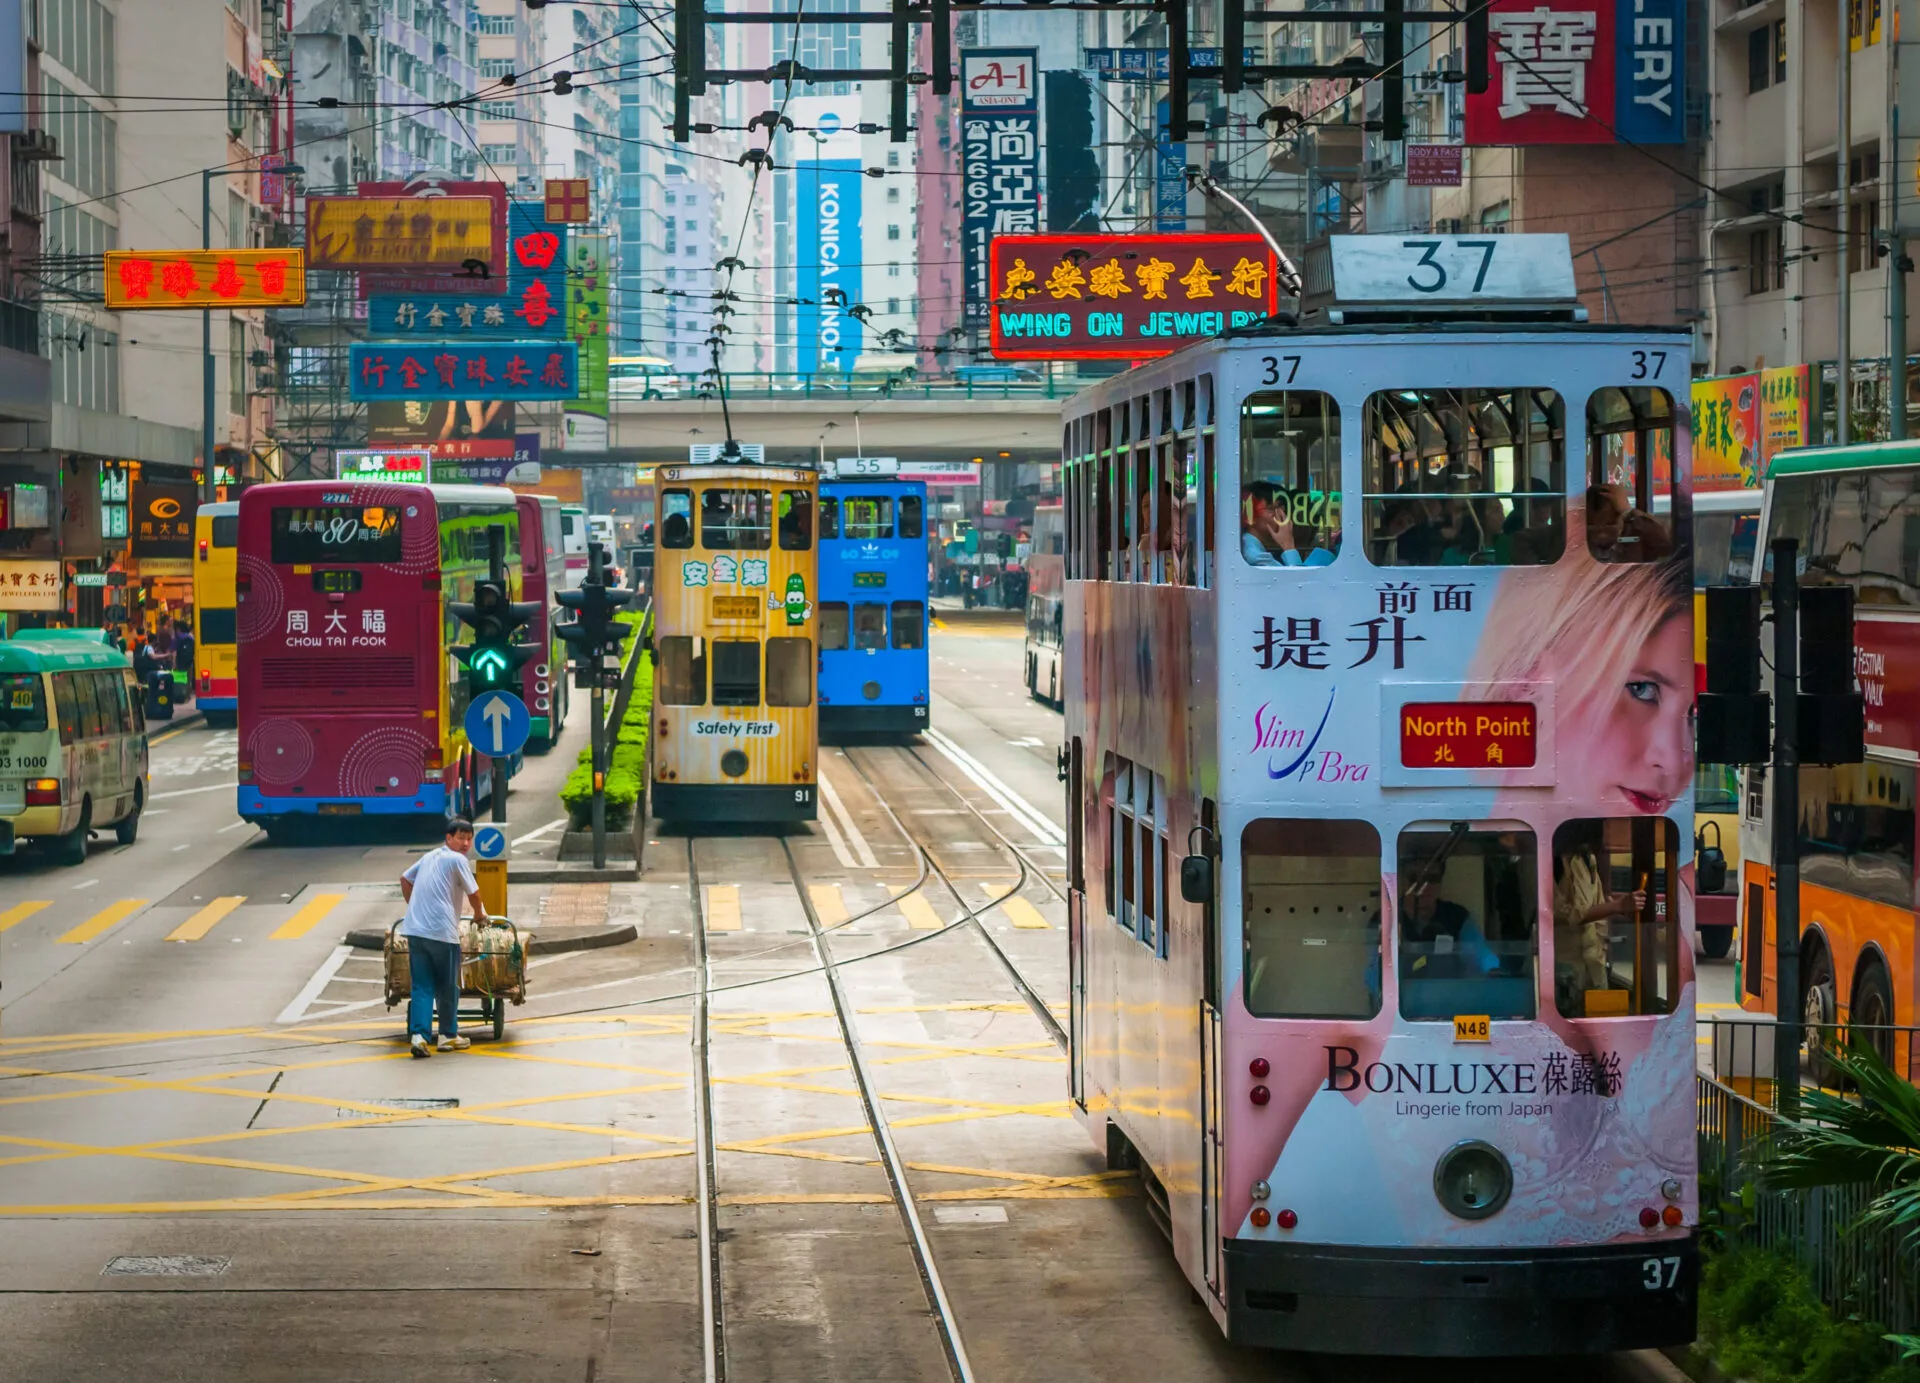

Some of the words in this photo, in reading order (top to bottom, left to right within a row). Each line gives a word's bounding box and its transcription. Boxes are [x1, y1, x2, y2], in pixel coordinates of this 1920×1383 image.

[970, 62, 1028, 89] A-1
[1489, 7, 1597, 119] 寶
[978, 96, 1018, 105] ASIA-ONE
[820, 183, 840, 276] KONICA
[1000, 257, 1268, 300] 永安珠寶金行
[1403, 240, 1497, 293] 37
[820, 283, 840, 371] MINOLT
[1000, 312, 1072, 337] WING
[1087, 312, 1123, 337] ON
[1261, 355, 1302, 385] 37
[1630, 351, 1667, 380] 37
[668, 469, 681, 480] 91
[793, 470, 807, 481] 91
[856, 459, 880, 473] 55
[1375, 582, 1477, 614] 前面
[286, 609, 386, 634] 周大福
[286, 637, 322, 647] CHOW
[326, 637, 346, 647] TAI
[352, 637, 386, 647] FOOK
[1252, 615, 1427, 671] 提升
[915, 707, 926, 717] 55
[697, 721, 742, 737] Safety
[746, 721, 774, 735] First
[1250, 700, 1305, 755] Slim
[1405, 716, 1467, 736] North
[1476, 716, 1531, 736] Point
[17, 756, 47, 768] 1000
[1434, 743, 1504, 764] 北角
[1316, 751, 1371, 784] Bra
[795, 790, 809, 802] 91
[1457, 1021, 1488, 1038] N48
[1322, 1045, 1537, 1095] BONLUXE
[1396, 1101, 1461, 1118] Lingerie
[1465, 1101, 1503, 1116] from
[1508, 1101, 1553, 1118] Japan
[1643, 1256, 1681, 1290] 37
